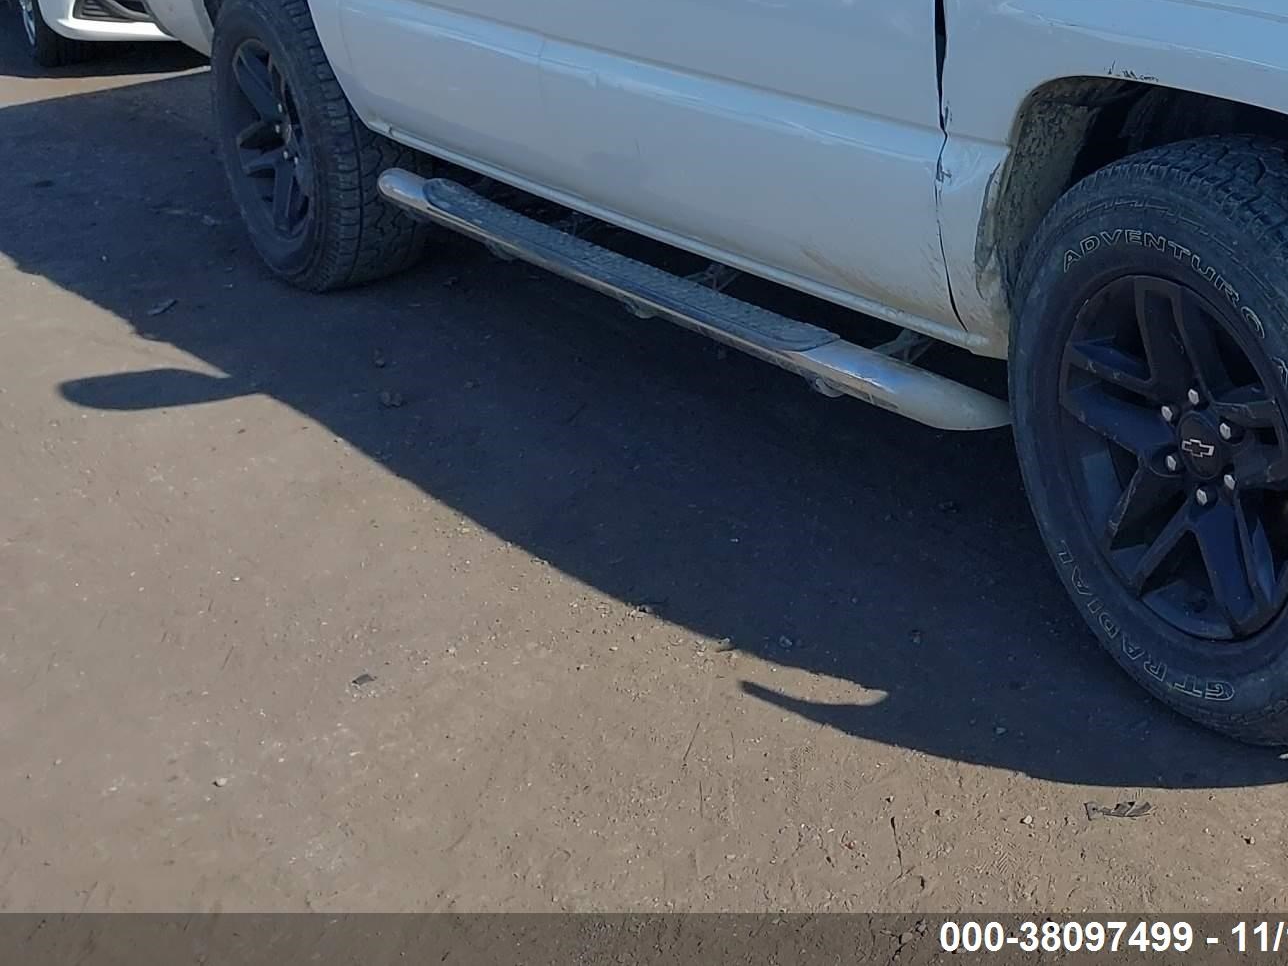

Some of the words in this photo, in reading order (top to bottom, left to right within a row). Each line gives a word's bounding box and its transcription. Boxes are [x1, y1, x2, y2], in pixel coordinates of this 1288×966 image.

[1063, 228, 1266, 339] ADVENTURO
[1056, 539, 1168, 683] RADIAL
[1173, 675, 1236, 702] GT
